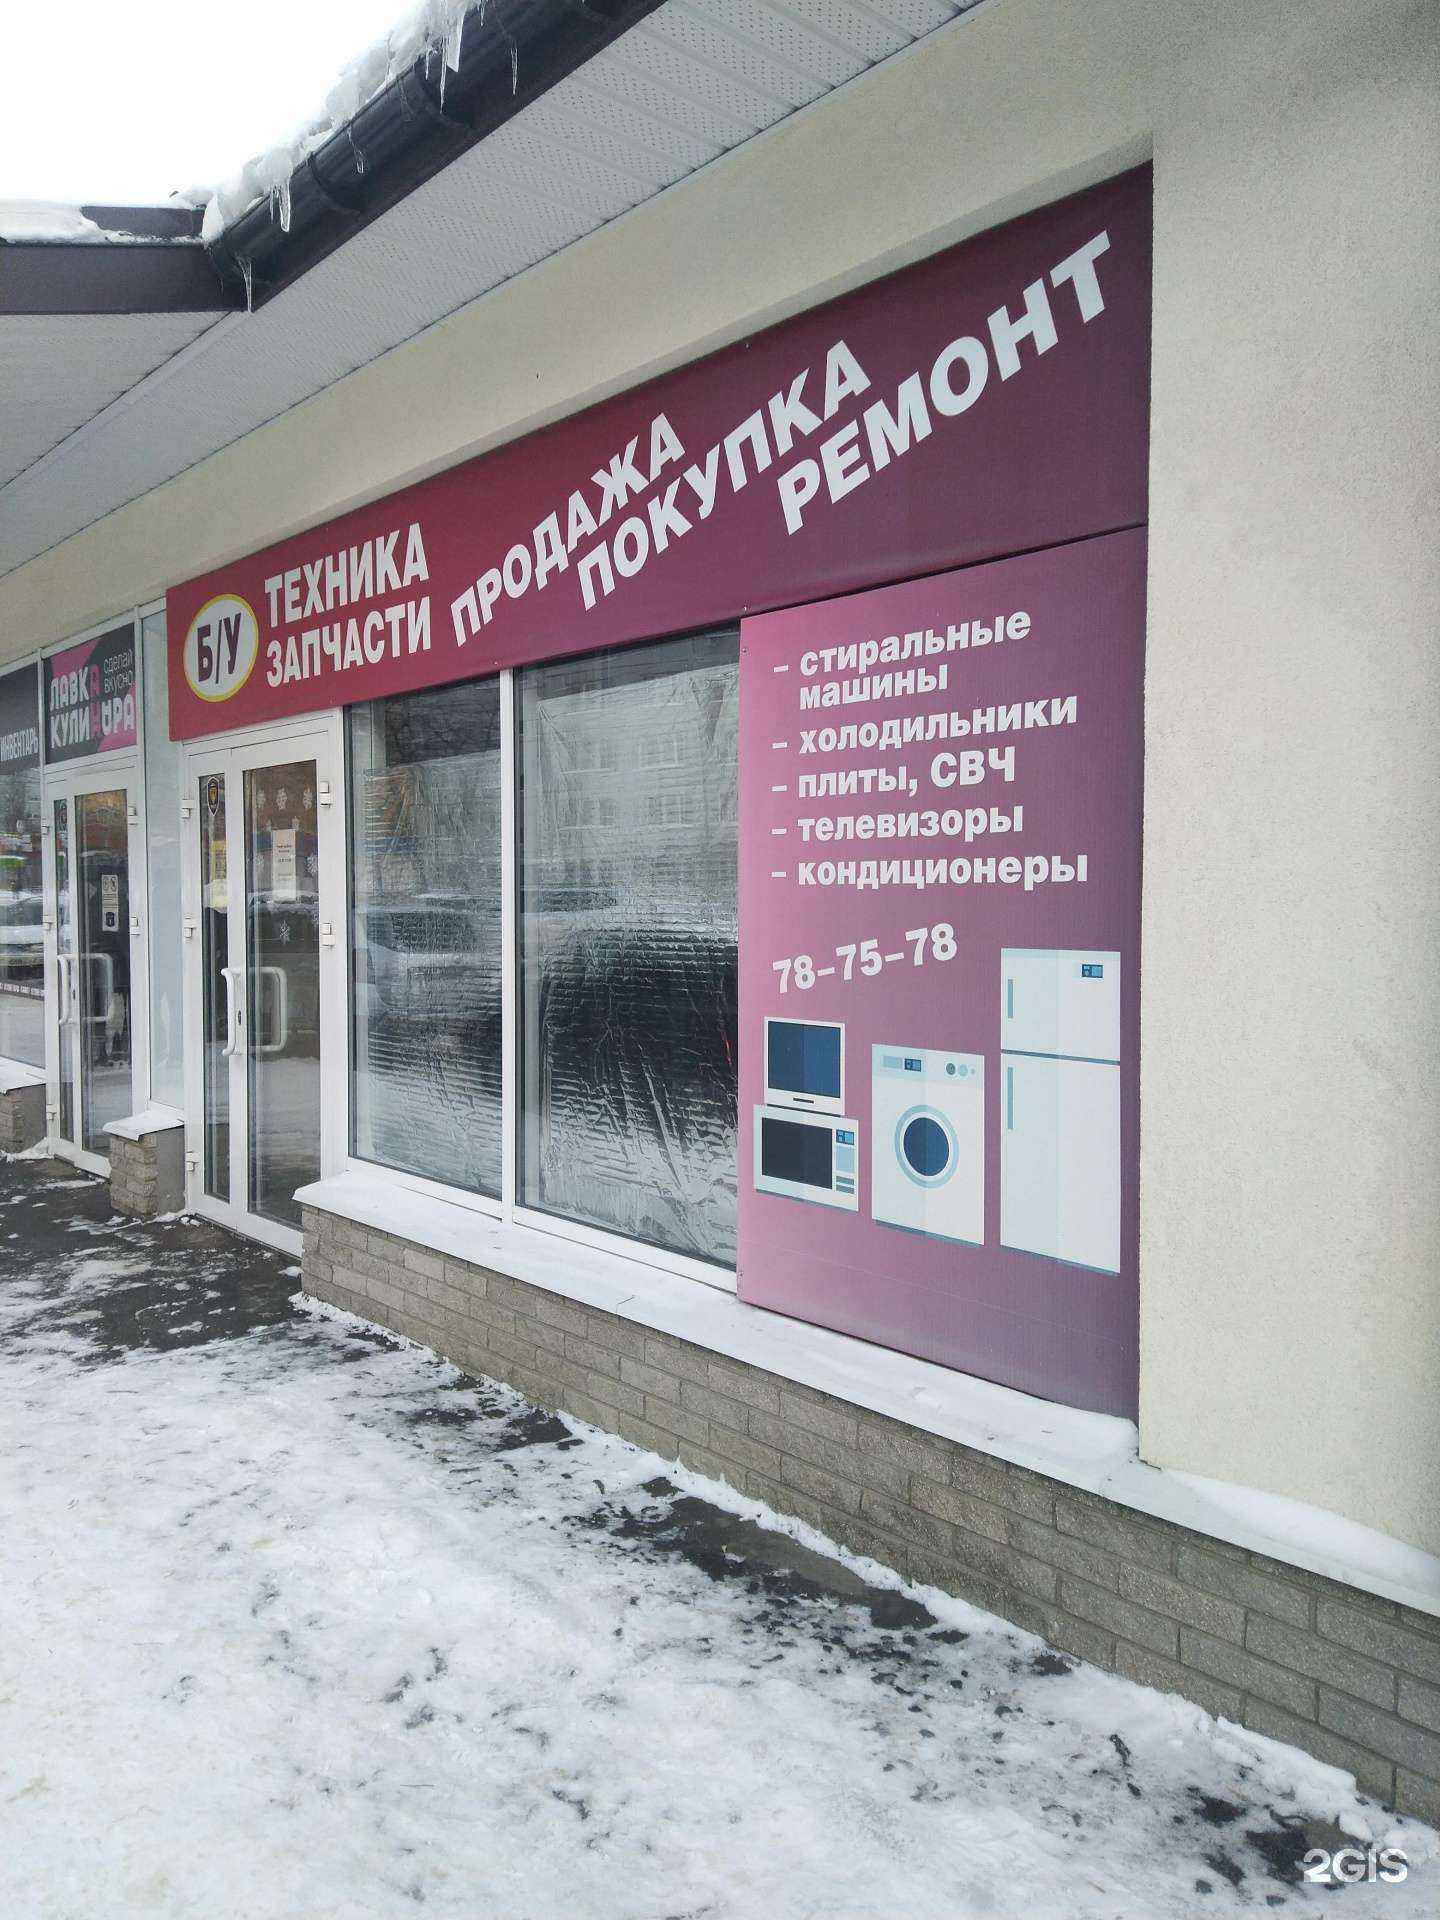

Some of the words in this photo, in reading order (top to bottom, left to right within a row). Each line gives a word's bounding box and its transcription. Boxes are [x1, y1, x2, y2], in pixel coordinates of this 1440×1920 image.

[776, 230, 1111, 536] РЕМОНТ
[576, 340, 871, 611] ПОКУПКА
[450, 412, 686, 647] ПРОДАЖА
[264, 522, 430, 629] ТЕХНИКА
[196, 612, 242, 684] Б/У
[265, 596, 432, 688] ЗАПЧАСТИ
[799, 611, 1032, 677] стиральные
[799, 664, 949, 710] машины
[799, 696, 1078, 754] холодильники
[799, 766, 919, 798] плиты,
[930, 746, 1016, 788] СВЧ
[798, 805, 1024, 842] телевизоры
[797, 854, 1088, 891] кондиционеры
